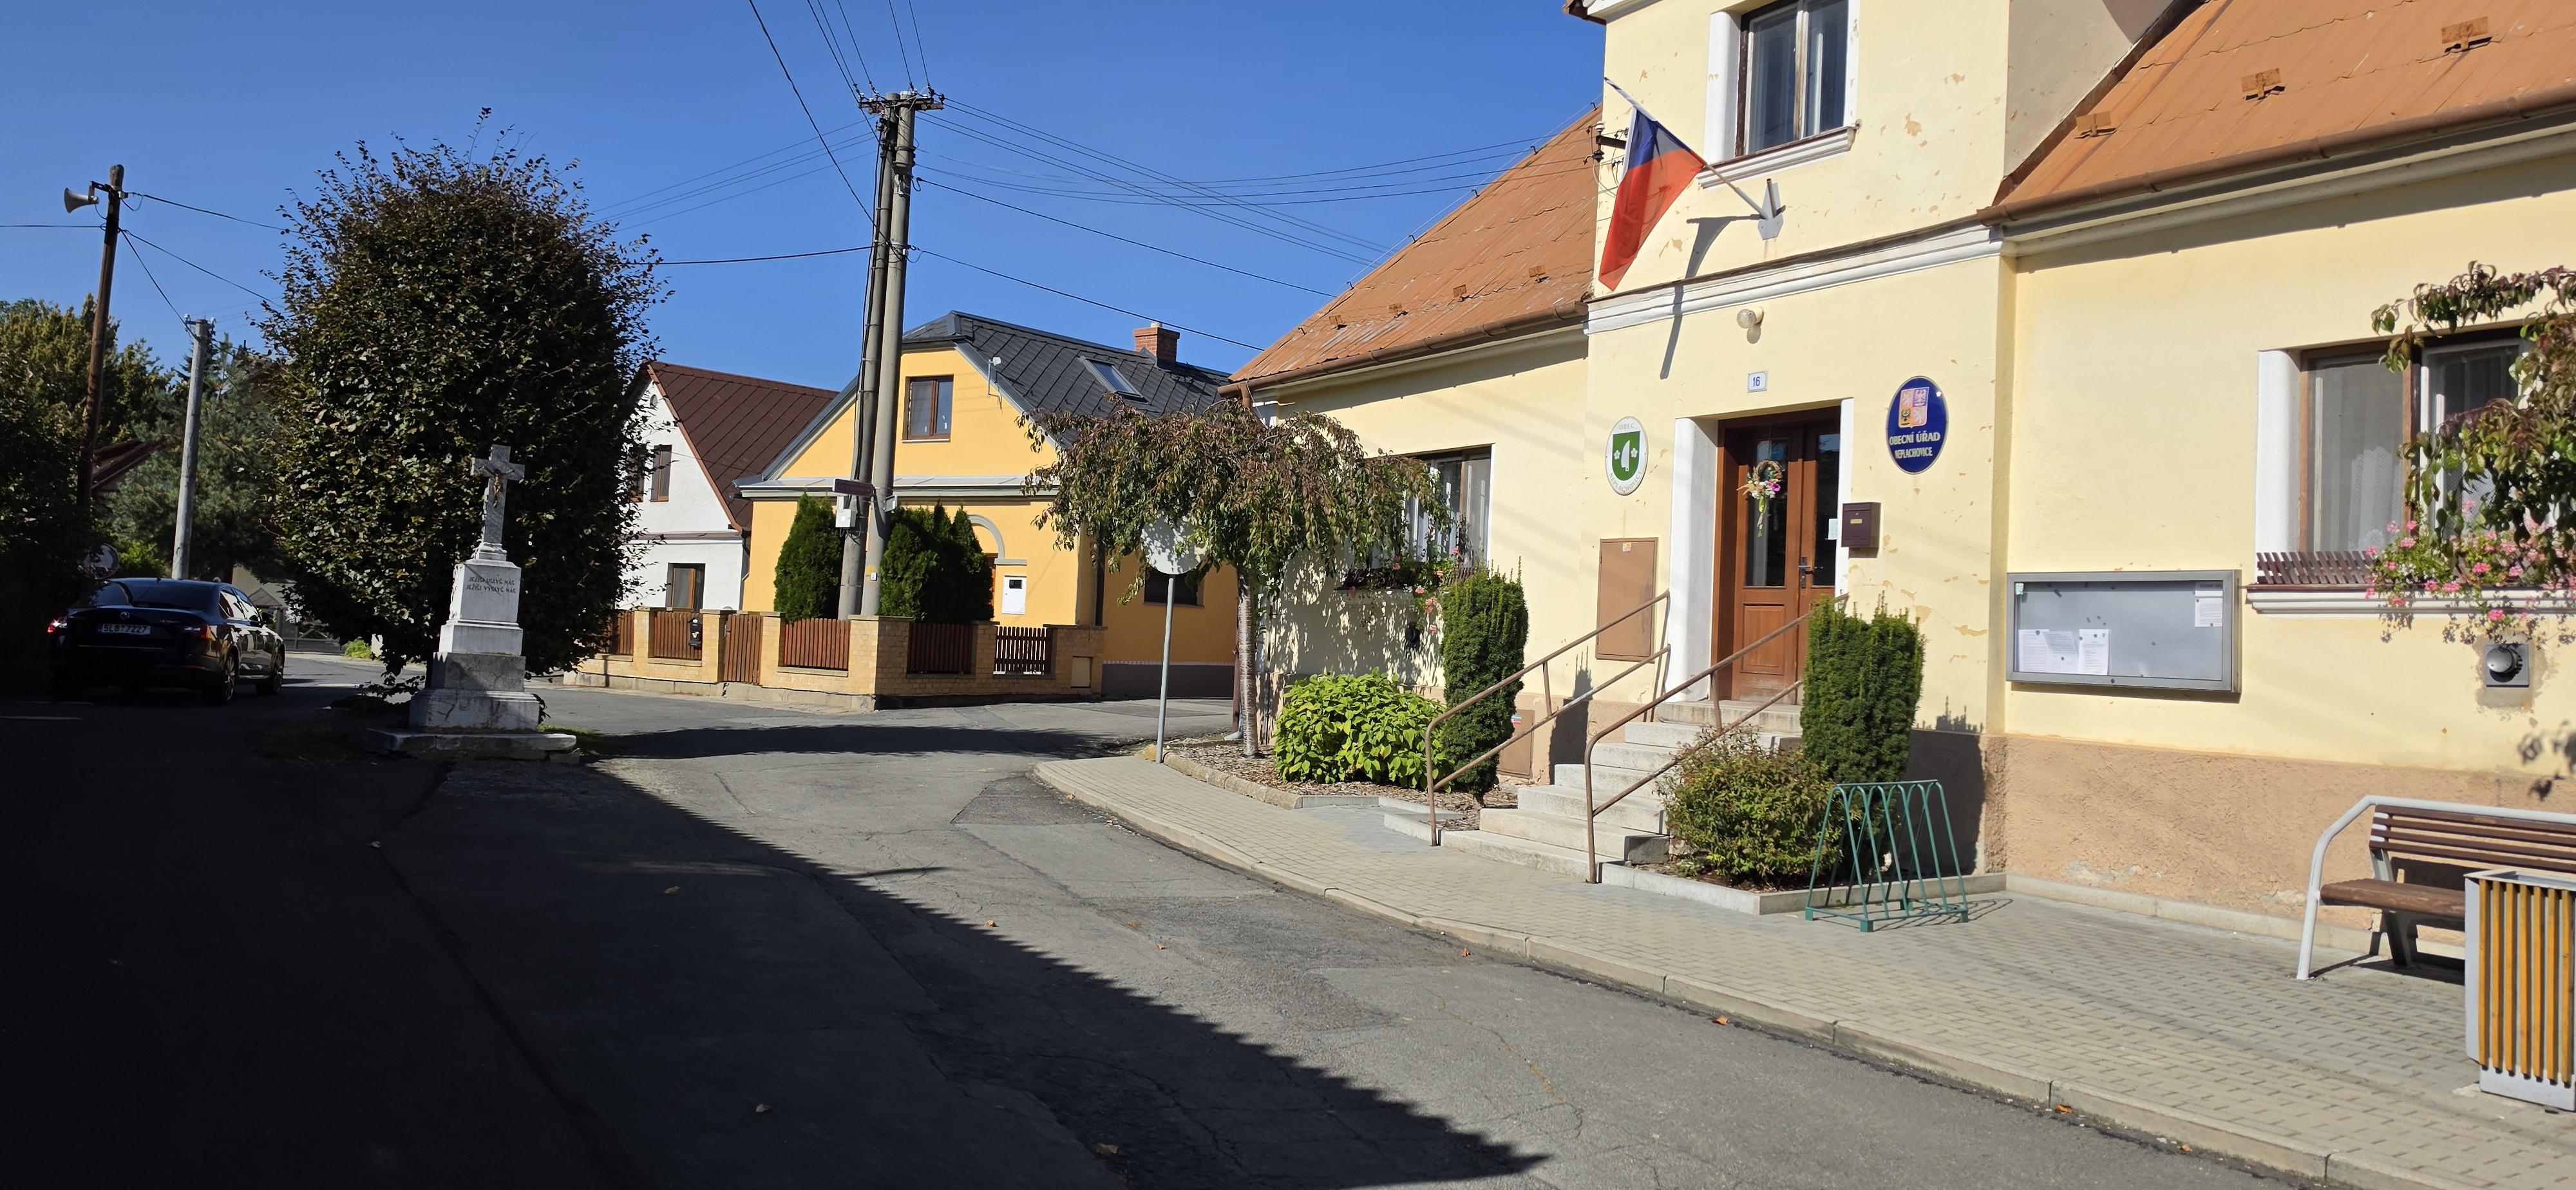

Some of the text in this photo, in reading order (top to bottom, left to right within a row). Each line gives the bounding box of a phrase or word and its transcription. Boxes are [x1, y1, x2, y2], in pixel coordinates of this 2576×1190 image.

[1753, 376, 1761, 387] 16
[1889, 430, 1940, 446] OBECNÍ ÚŘAD
[1895, 447, 1933, 458] NEPLACHOVICE
[126, 625, 147, 633] 7227
